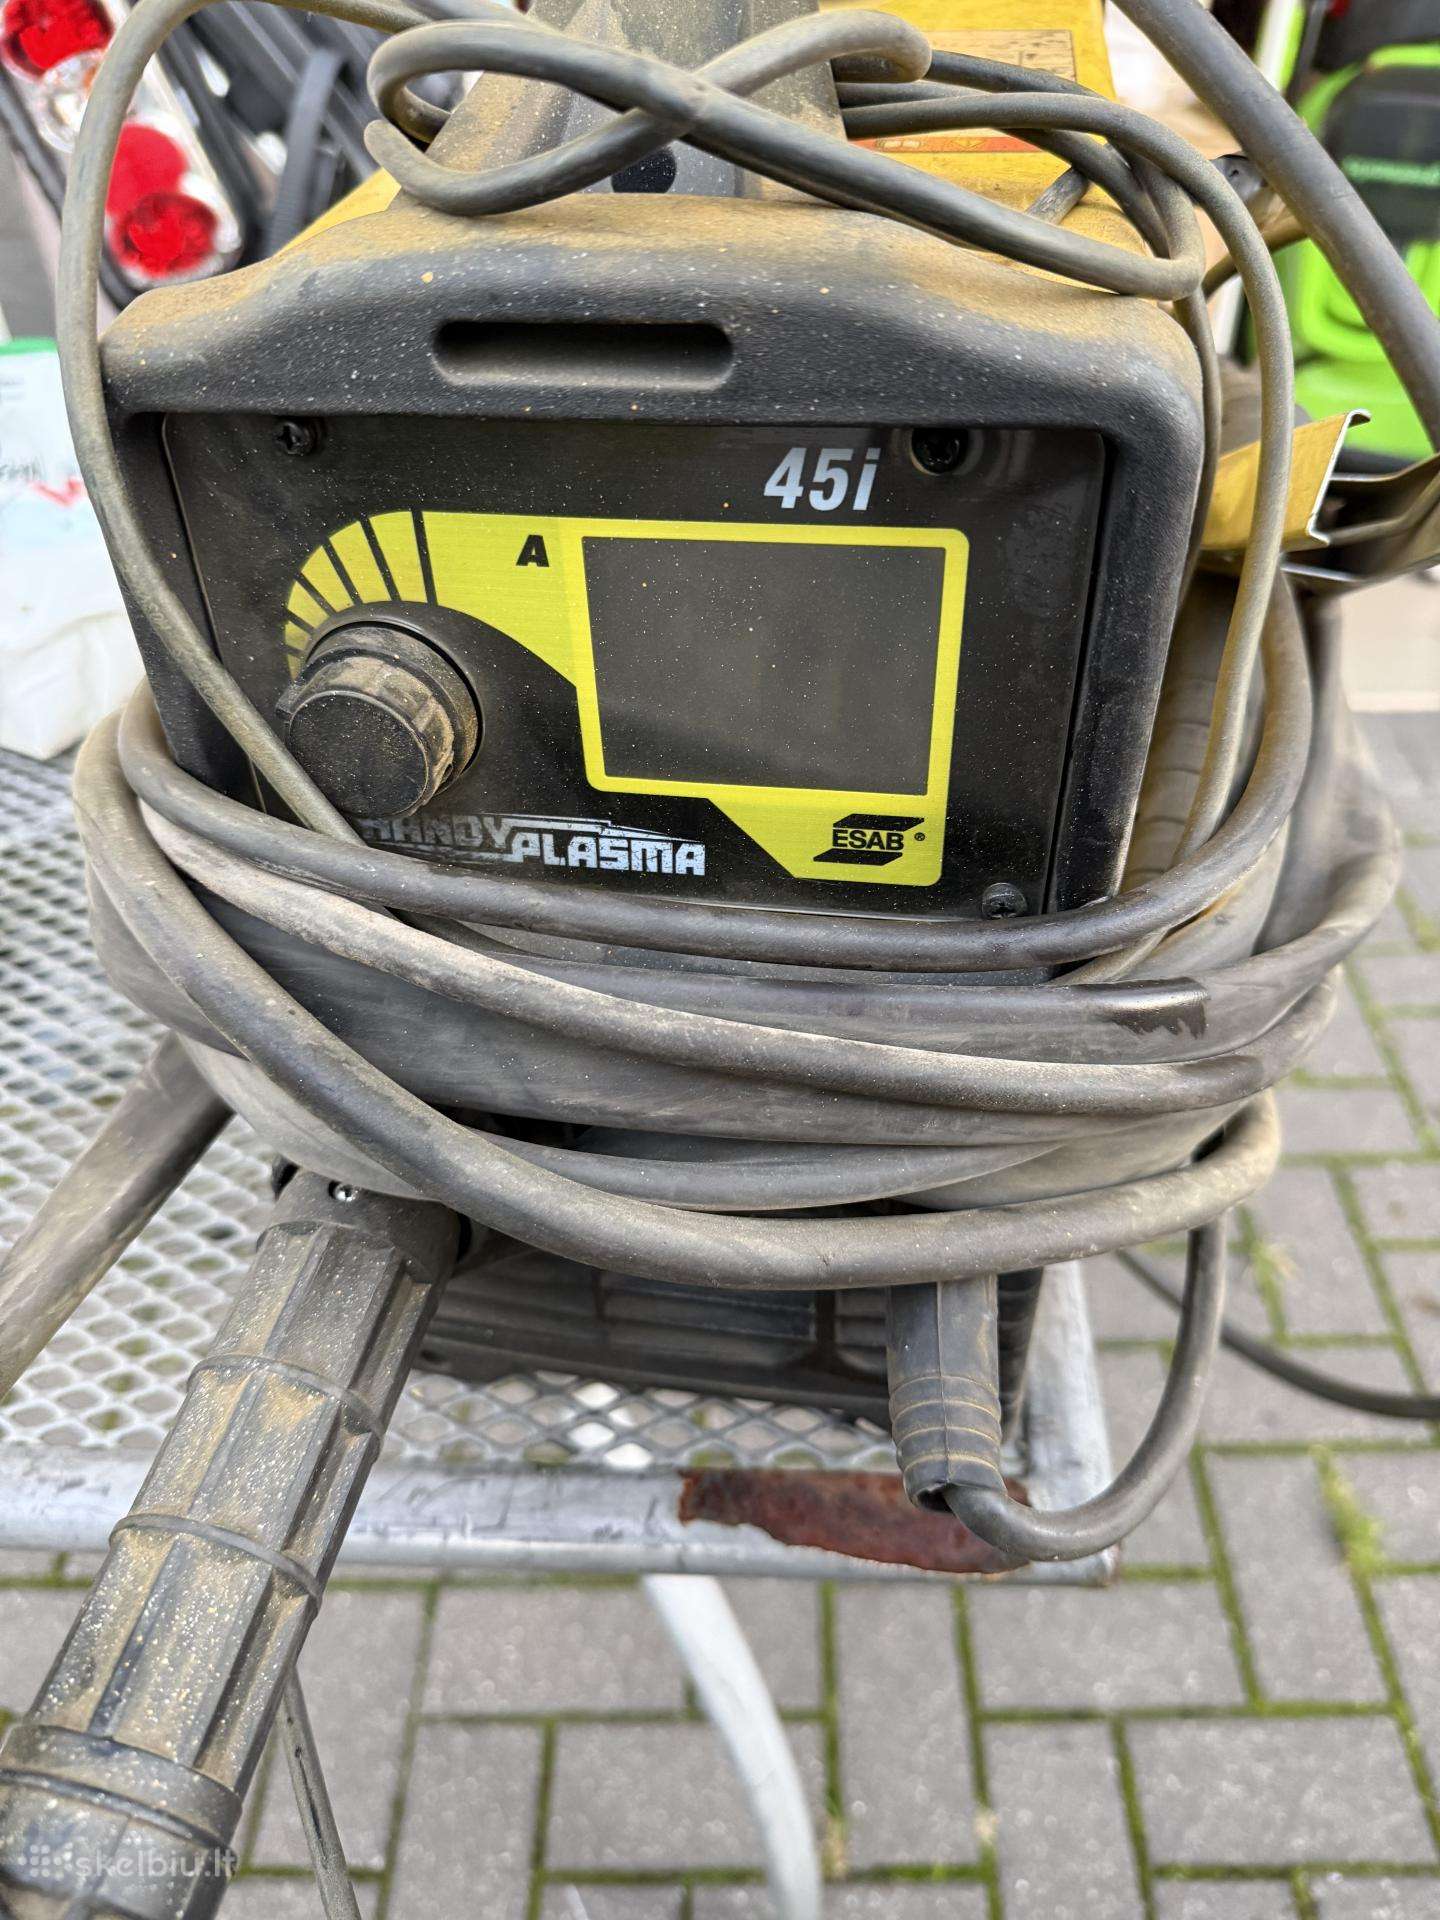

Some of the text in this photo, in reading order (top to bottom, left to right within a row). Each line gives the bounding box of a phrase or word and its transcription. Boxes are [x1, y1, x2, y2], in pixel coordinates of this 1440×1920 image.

[764, 447, 881, 511] 45i
[515, 534, 550, 568] A
[832, 829, 904, 851] ESAB
